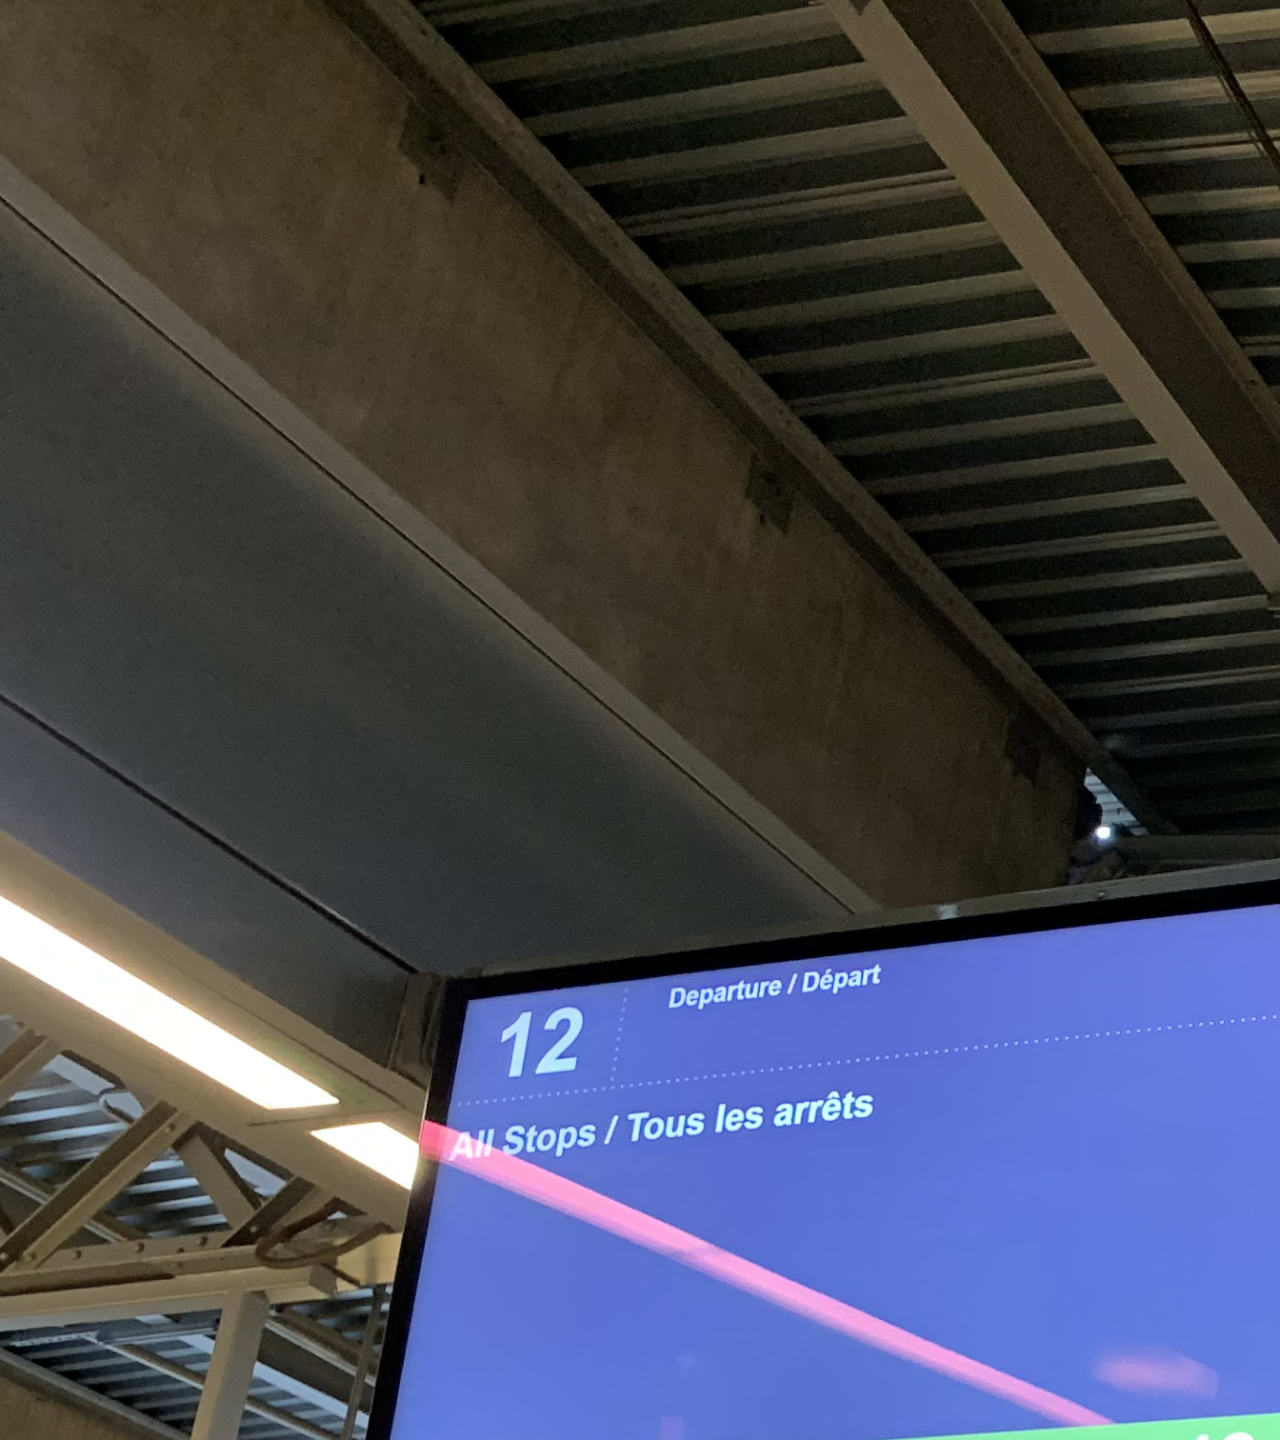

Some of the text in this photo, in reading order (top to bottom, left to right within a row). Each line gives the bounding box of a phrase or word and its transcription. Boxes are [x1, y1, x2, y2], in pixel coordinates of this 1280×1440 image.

[668, 964, 882, 1010] Departure / Départ
[500, 1006, 584, 1078] 12
[449, 1091, 875, 1161] All Stops / Tous les arrêts
